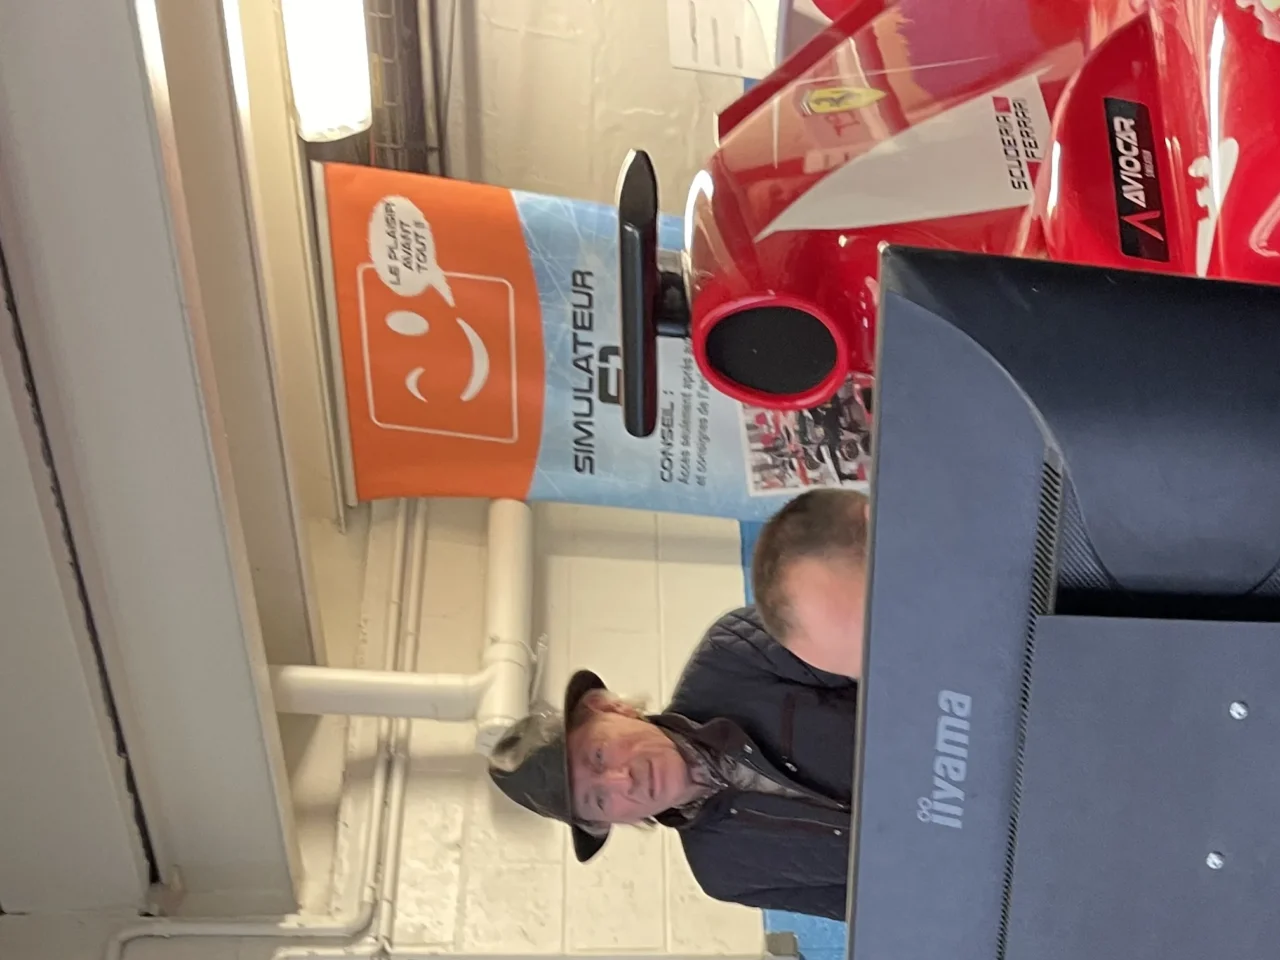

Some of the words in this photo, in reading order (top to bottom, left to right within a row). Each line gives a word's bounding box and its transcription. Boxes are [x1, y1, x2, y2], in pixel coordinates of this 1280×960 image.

[995, 115, 1028, 191] SCUDERIA
[1012, 98, 1043, 160] FERRARI
[1113, 116, 1147, 208] AVIOCAR
[384, 202, 398, 261] PLAISIR
[399, 219, 414, 272] AVANT
[413, 231, 428, 274] TOUT
[387, 264, 401, 286] LE
[571, 269, 595, 475] SIMULATEUR
[660, 401, 674, 483] CONSEIL
[916, 690, 972, 829] iiyama
